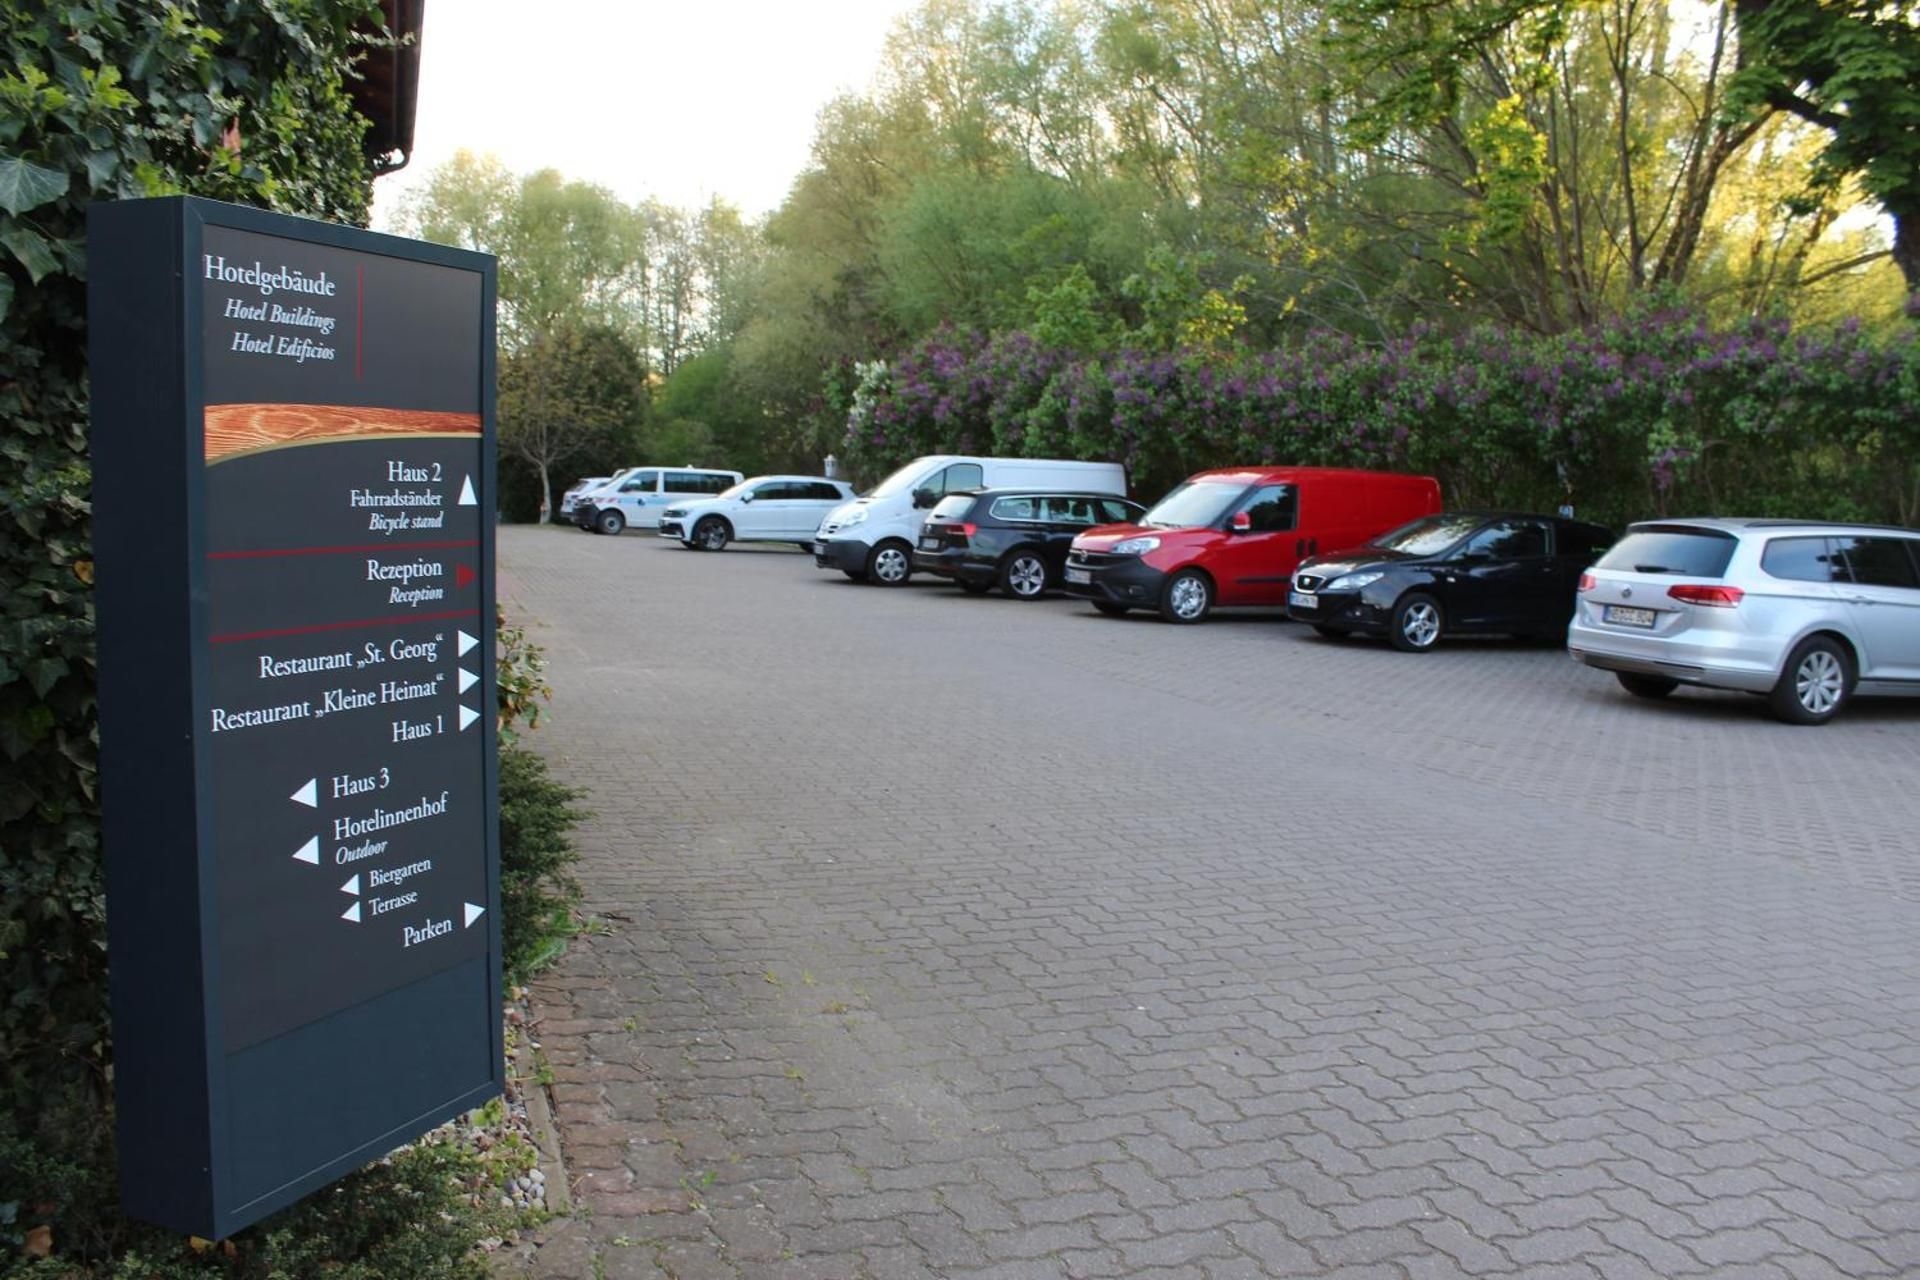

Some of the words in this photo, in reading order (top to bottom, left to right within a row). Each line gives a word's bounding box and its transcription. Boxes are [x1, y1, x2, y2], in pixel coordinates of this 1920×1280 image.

[203, 254, 336, 297] Hotelgebäude
[224, 297, 268, 322] Hotel
[269, 304, 336, 335] Buildings
[230, 331, 275, 354] Hotel
[276, 336, 336, 364] Edificios
[388, 460, 429, 482] Haus
[432, 462, 443, 482] 2
[350, 488, 443, 508] Fahrradständer
[368, 511, 411, 536] Bicycle
[411, 510, 445, 530] stand
[366, 557, 443, 586] Rezeption
[388, 584, 444, 608] Reception
[258, 650, 353, 679] Restaurant
[210, 700, 311, 733] Restaurant
[391, 720, 432, 743] Haus
[436, 714, 444, 734] 1
[332, 774, 376, 799] Haus
[379, 767, 390, 789] 3
[333, 790, 449, 841] Hotelinnenhof
[335, 839, 389, 865] Outdoor
[369, 859, 432, 888] Biergarten
[368, 890, 418, 916] Terrasse
[403, 917, 453, 948] Parken
